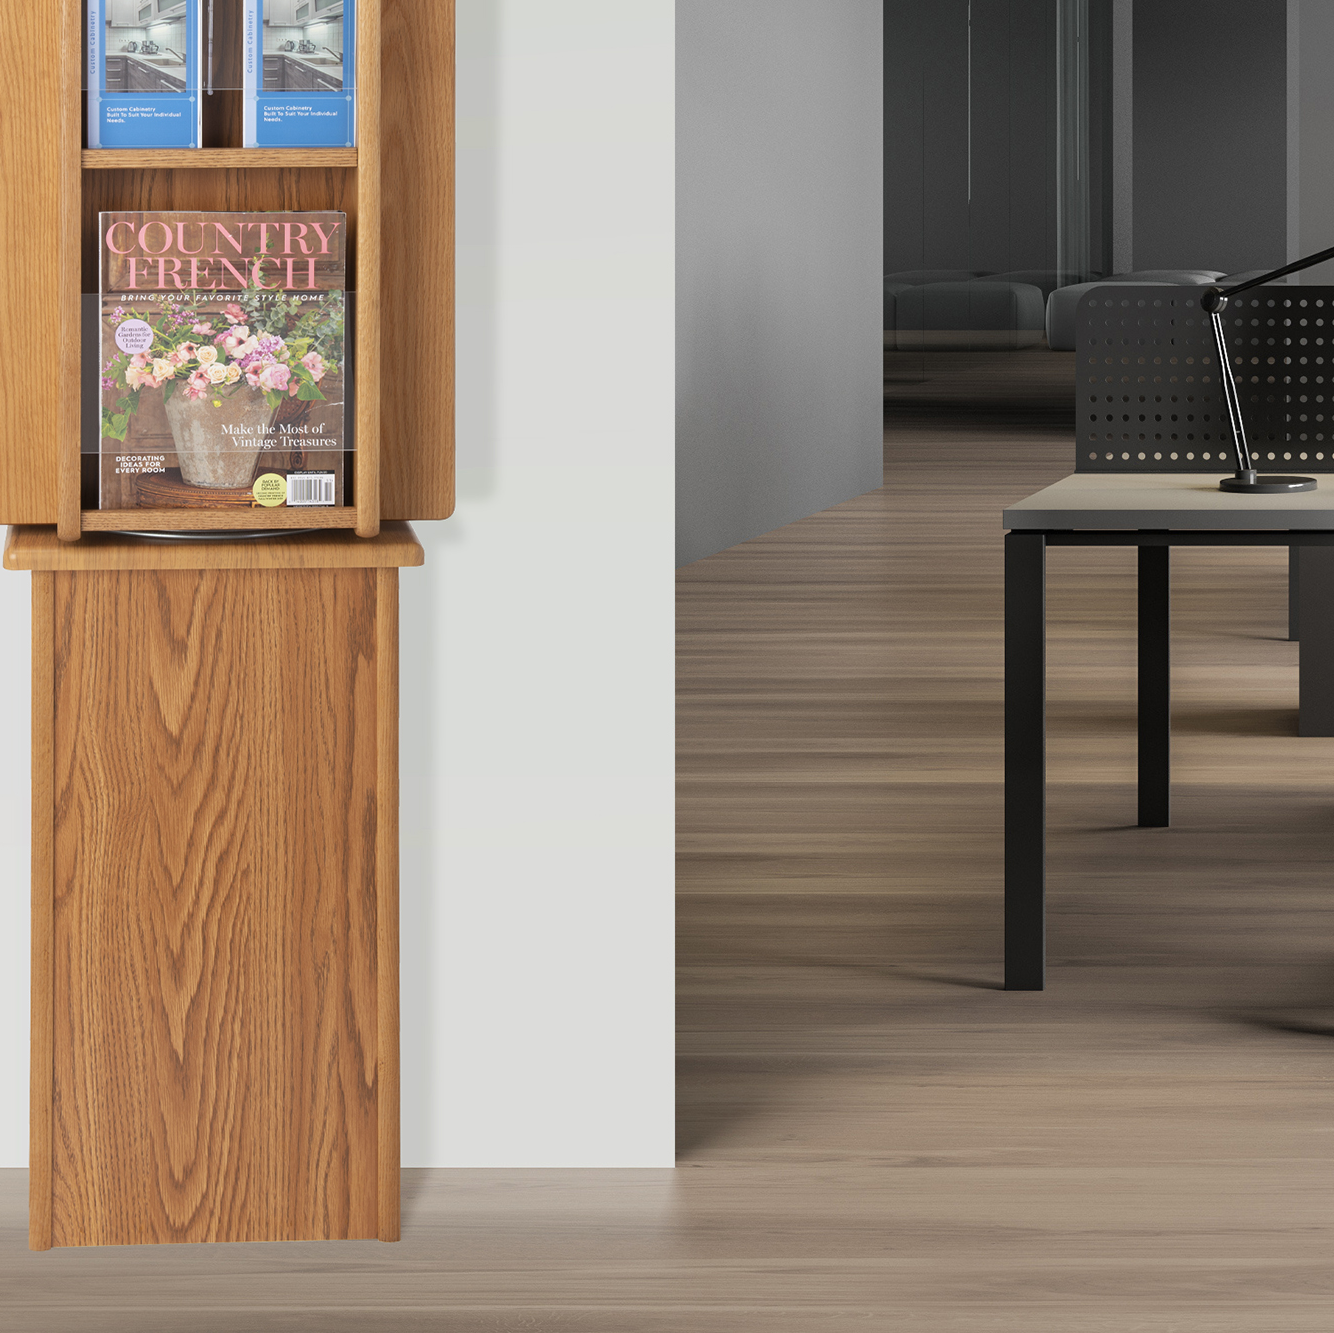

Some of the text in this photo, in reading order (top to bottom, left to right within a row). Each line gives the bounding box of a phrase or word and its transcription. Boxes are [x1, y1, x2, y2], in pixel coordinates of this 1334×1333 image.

[105, 221, 341, 255] COUNTRY
[125, 257, 319, 290] FRENCH
[221, 423, 325, 434] Make the Most of
[232, 436, 337, 449] Vintage Treasures
